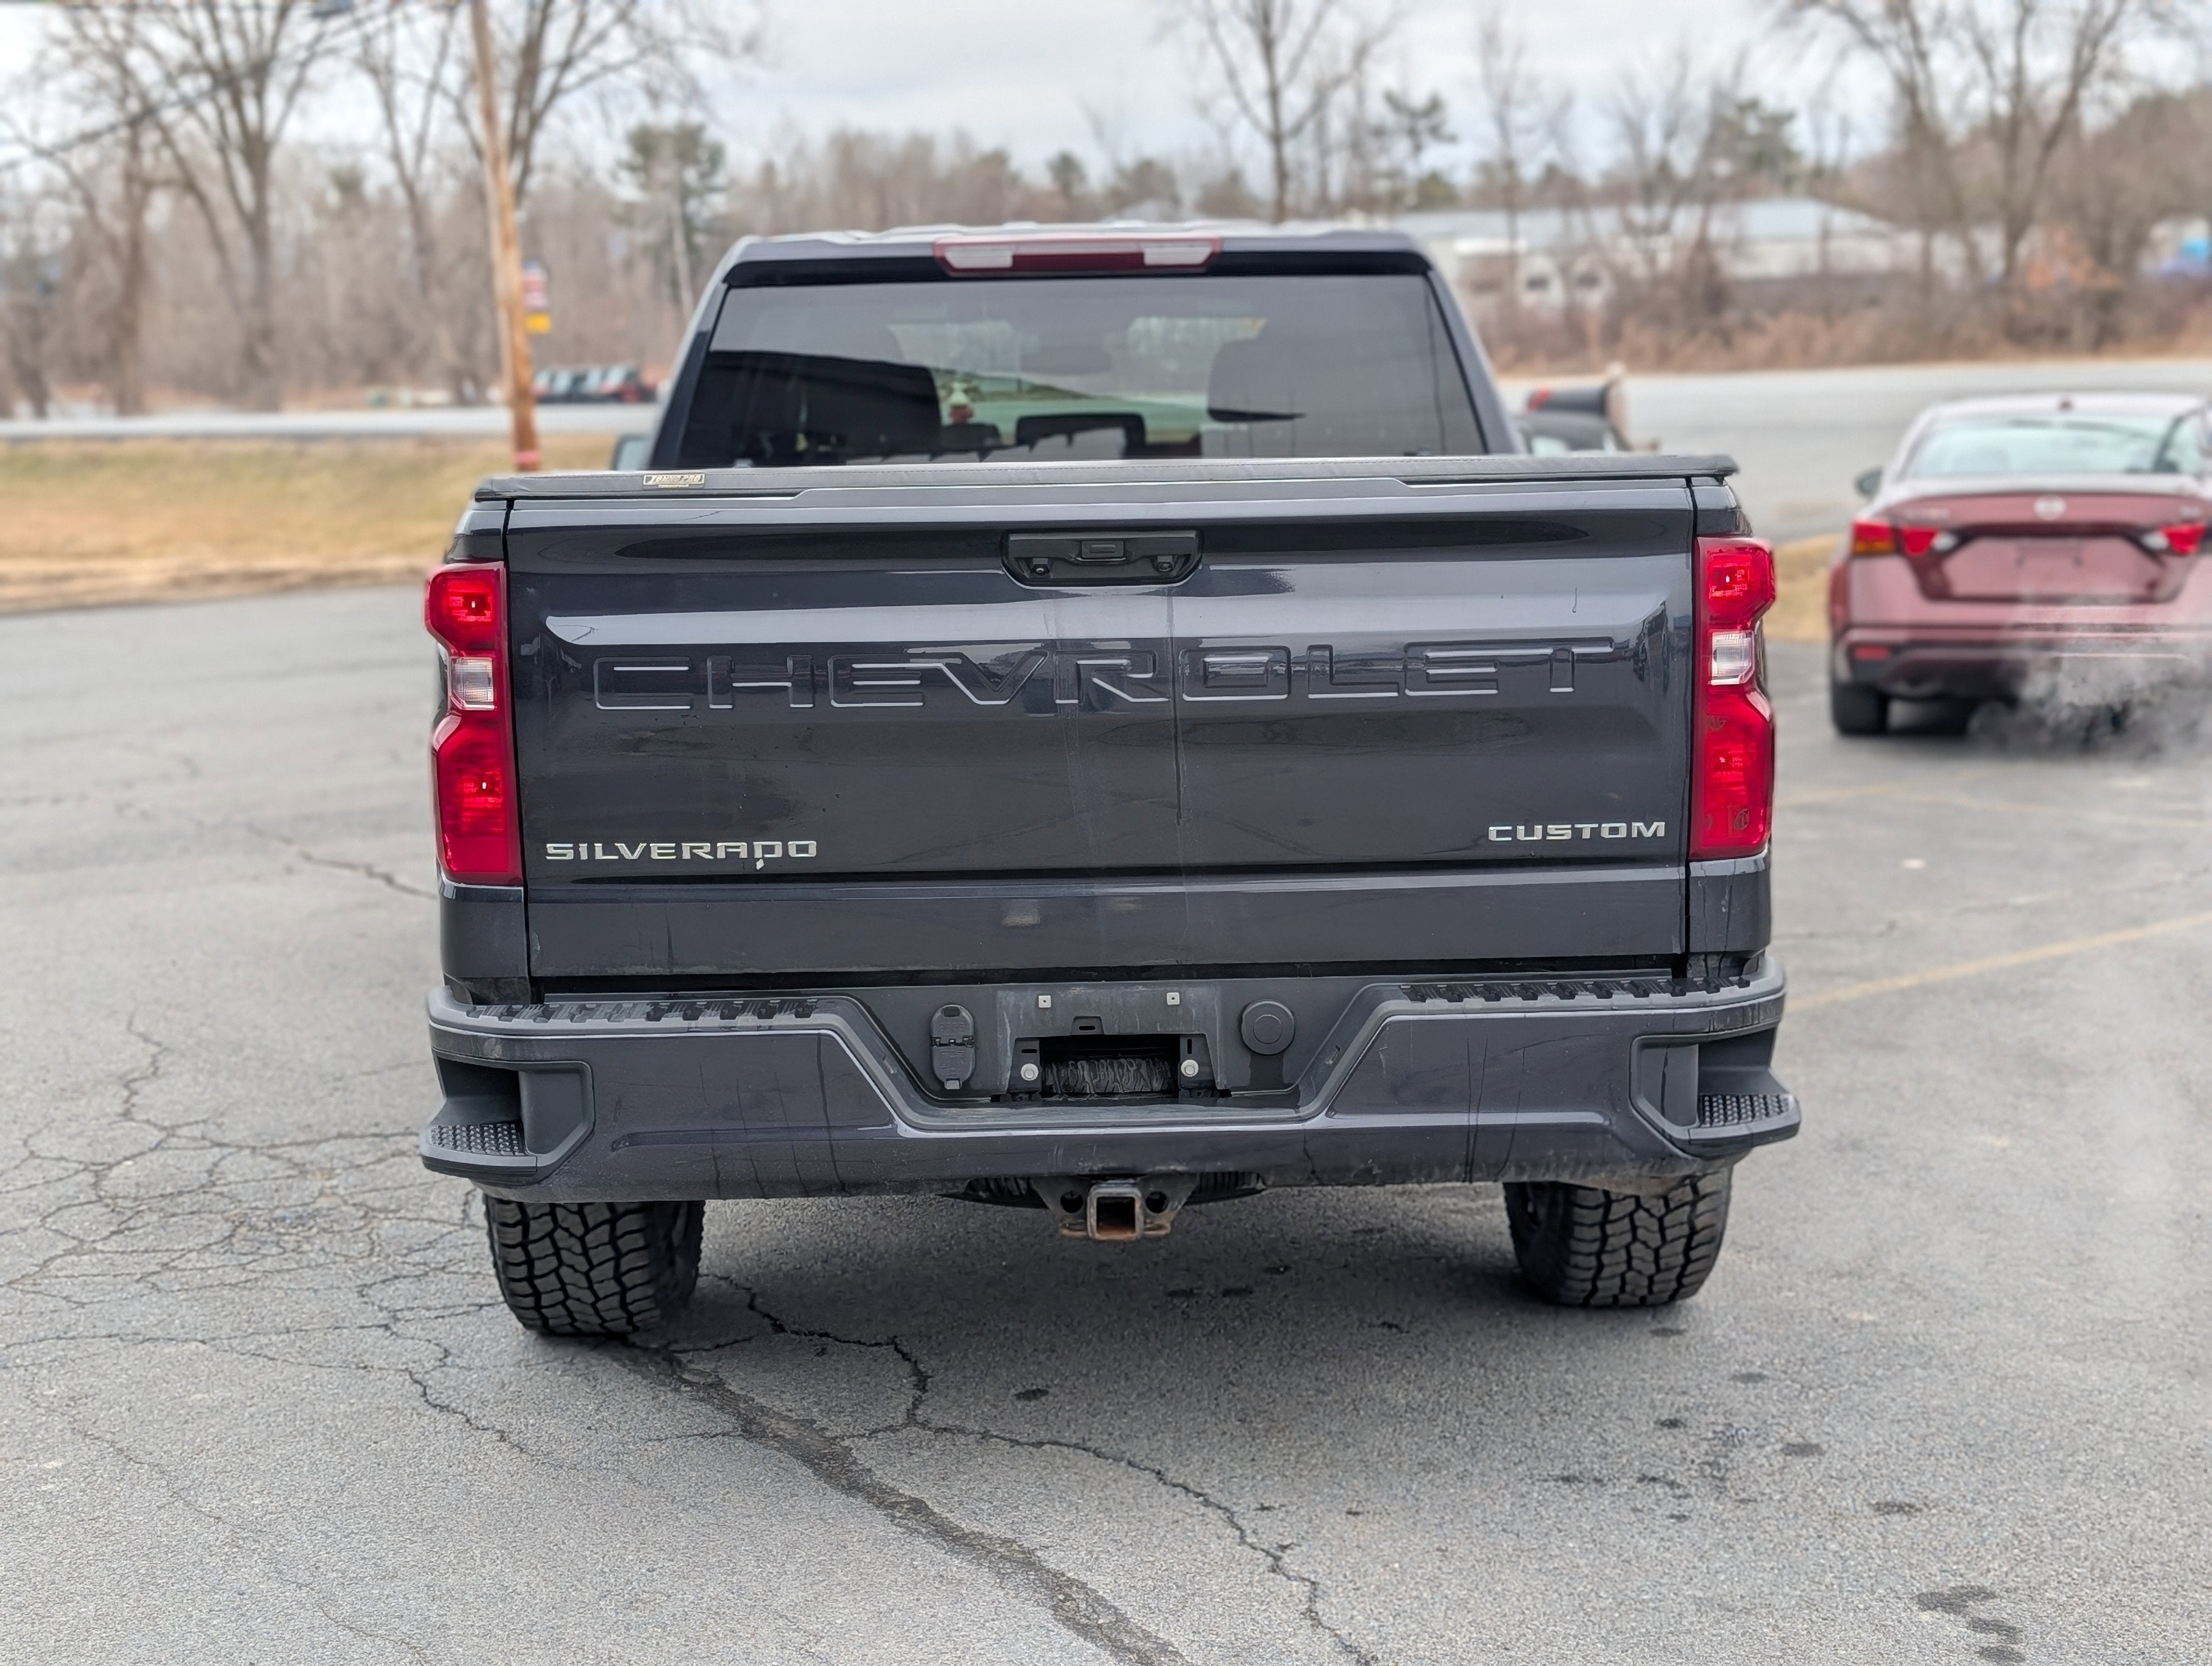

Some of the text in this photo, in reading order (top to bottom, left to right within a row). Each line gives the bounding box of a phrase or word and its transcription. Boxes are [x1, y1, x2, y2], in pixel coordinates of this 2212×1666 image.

[593, 636, 1615, 710] CHEVROLET
[1488, 821, 1666, 841] CUSTOM
[545, 841, 817, 861] SILVERADO
